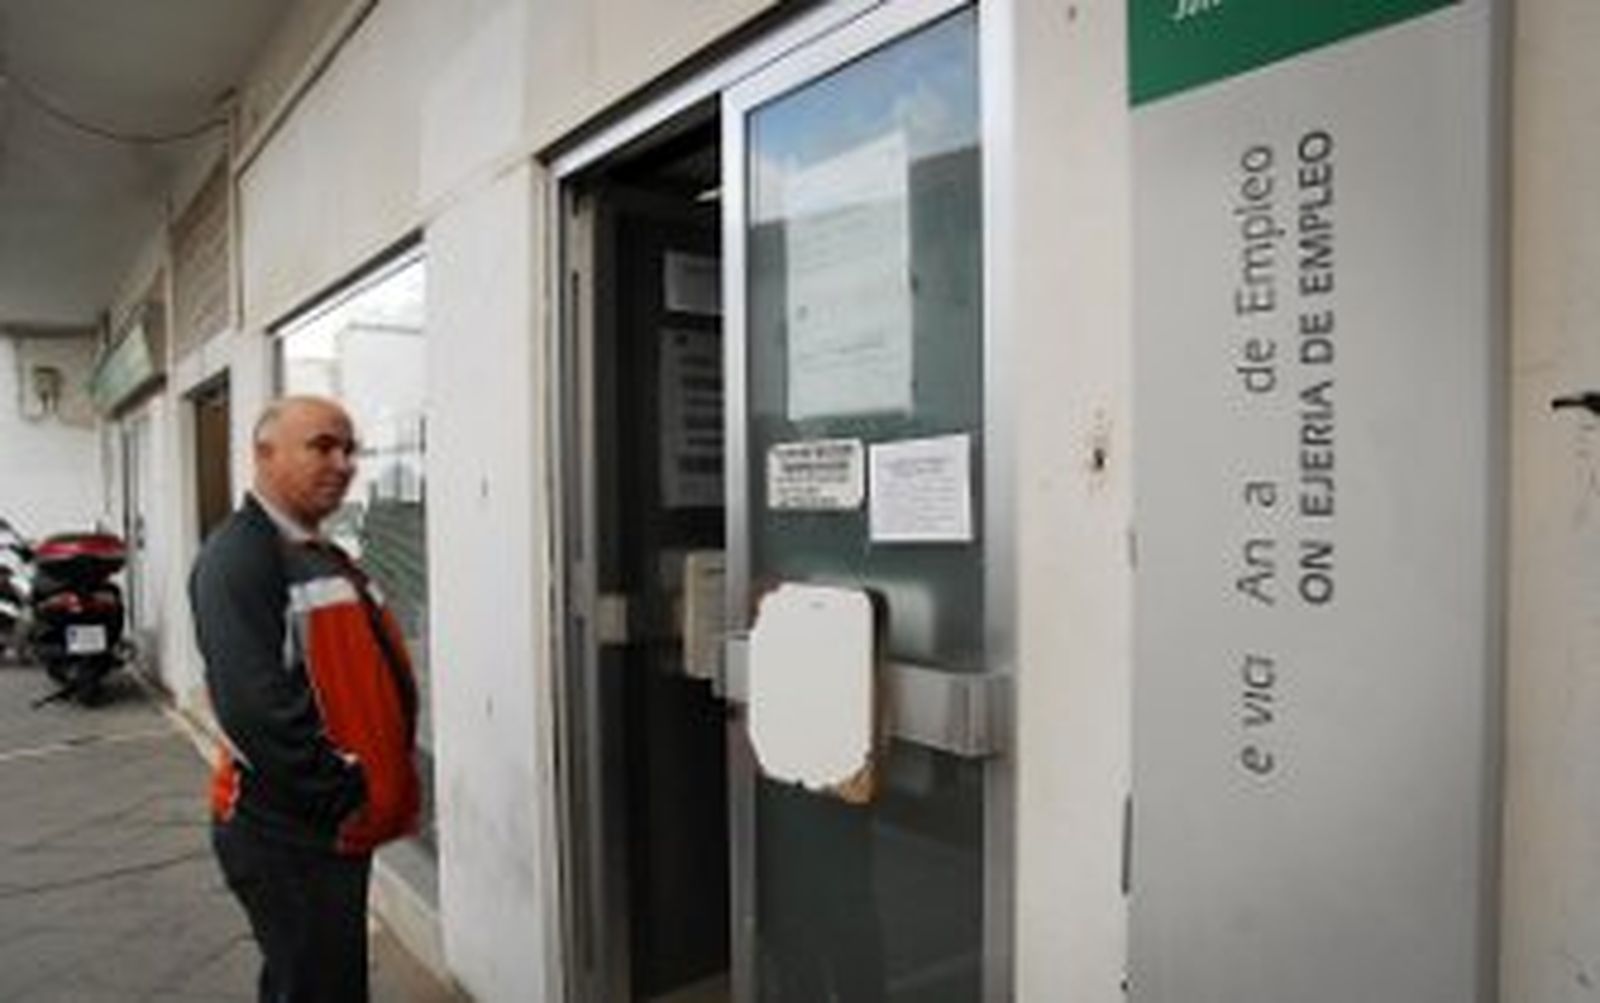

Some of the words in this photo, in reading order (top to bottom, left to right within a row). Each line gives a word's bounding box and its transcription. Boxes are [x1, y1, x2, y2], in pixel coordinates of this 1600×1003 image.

[1234, 145, 1286, 315] Empleo
[1298, 131, 1333, 296] EMPLEO
[1236, 338, 1276, 393] de
[1299, 310, 1334, 365] DE
[1300, 380, 1334, 516] EJERIA
